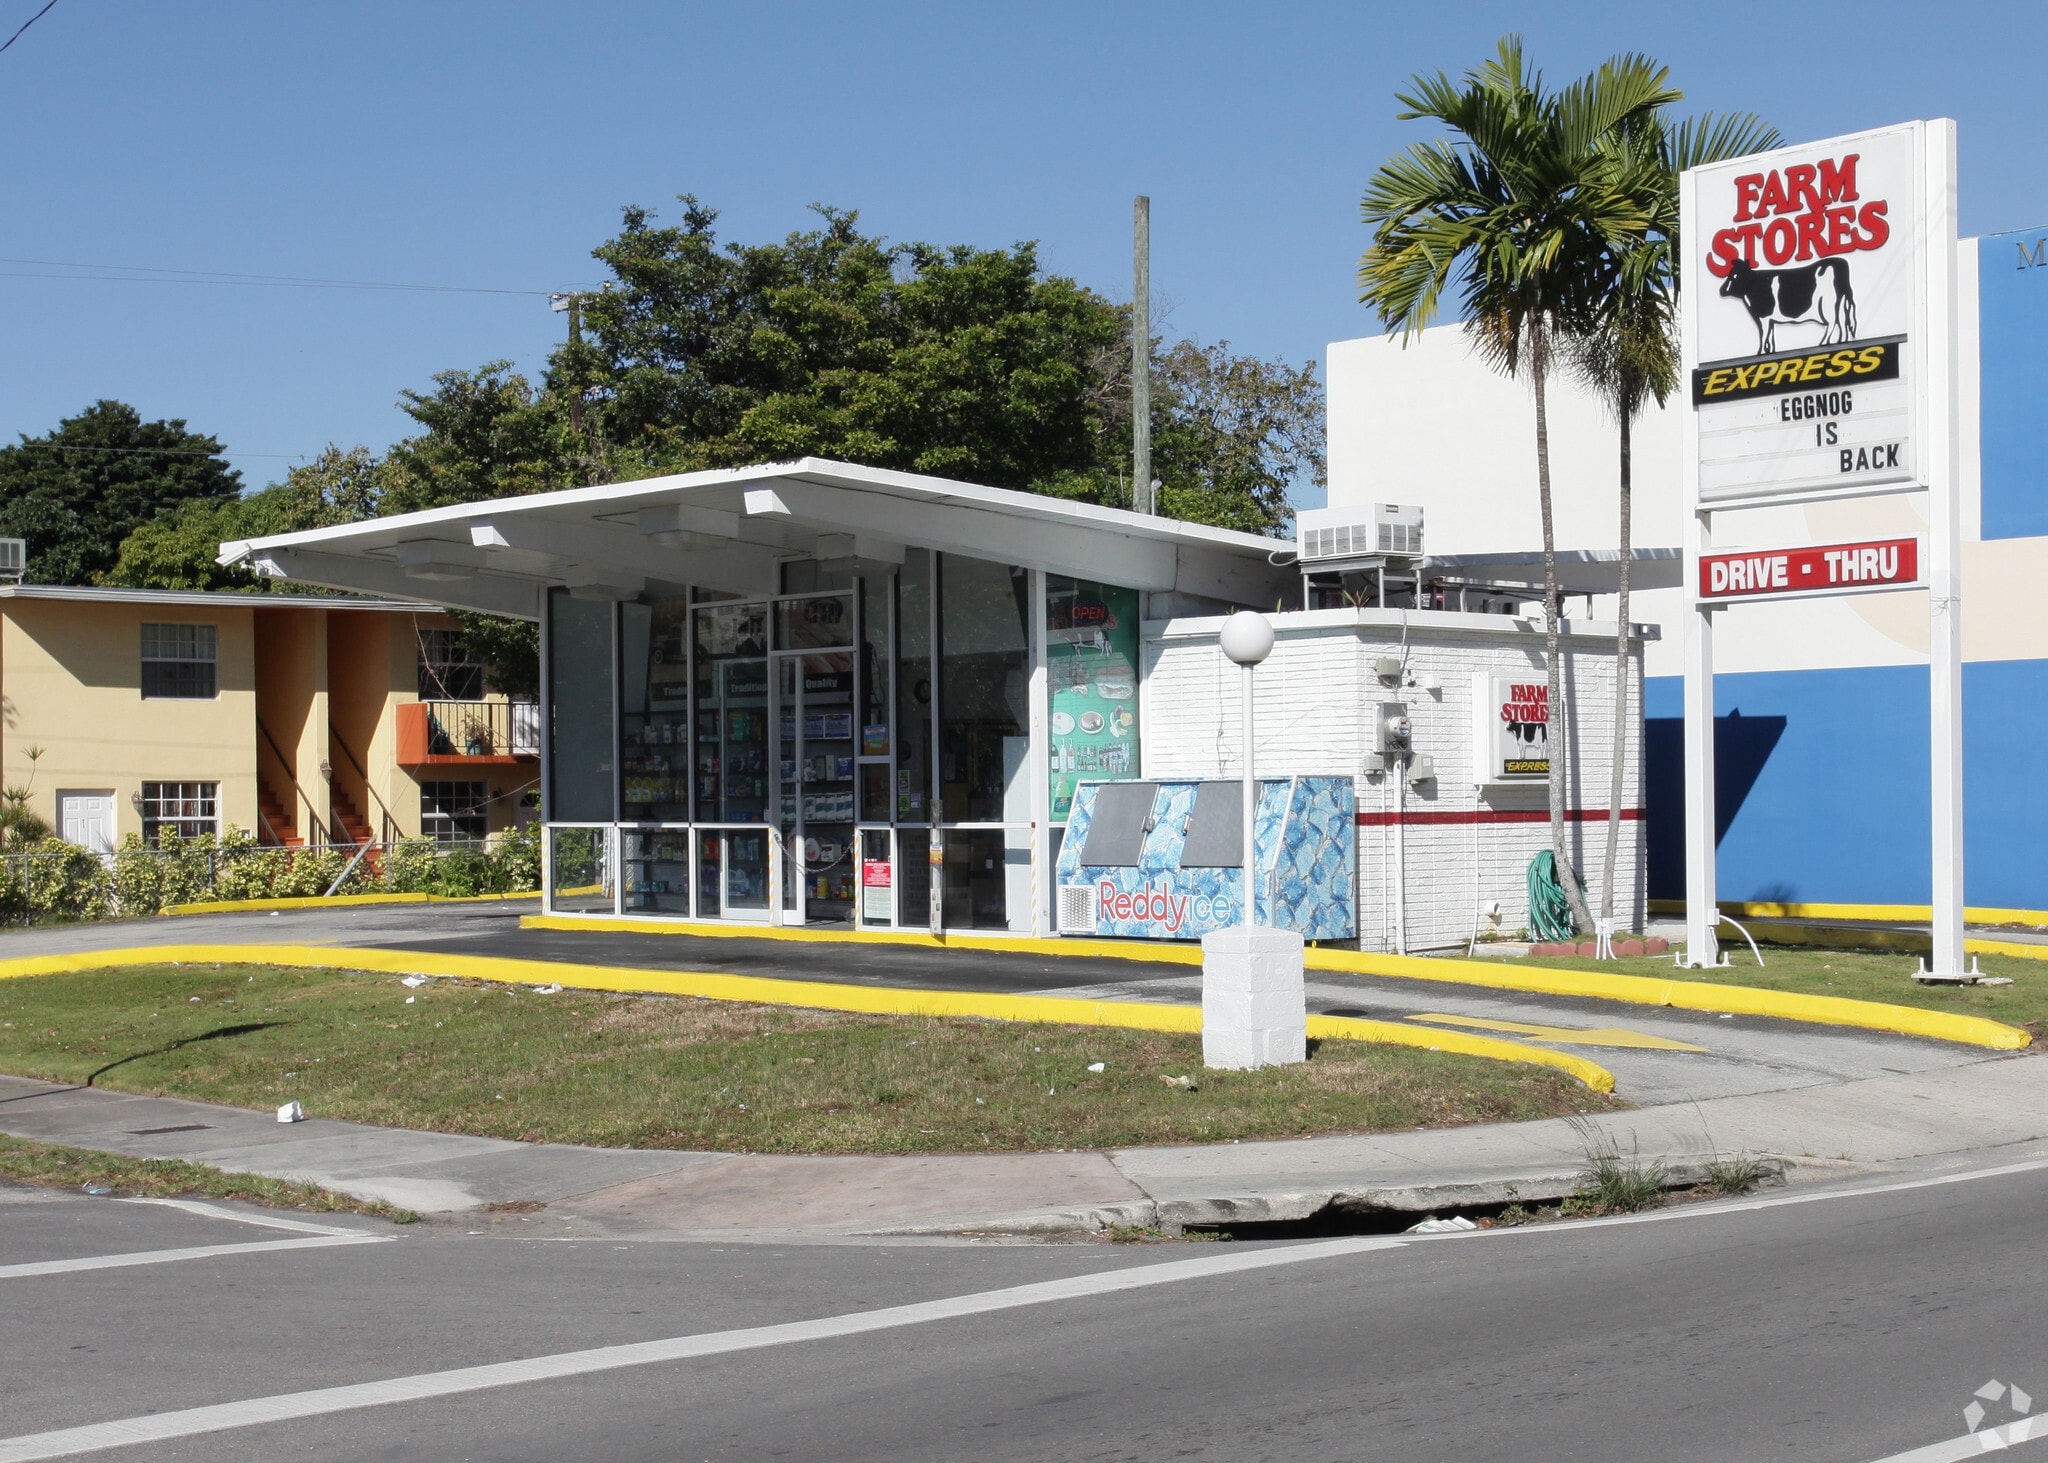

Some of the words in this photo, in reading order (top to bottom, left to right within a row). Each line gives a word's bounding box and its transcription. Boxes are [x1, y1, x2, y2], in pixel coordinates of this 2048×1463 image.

[1733, 154, 1861, 222] FARM
[1706, 199, 1890, 278] STORES
[1703, 345, 1885, 396] EXPRESS
[1780, 390, 1853, 423] EGGNOG
[1815, 422, 1838, 447] IS
[1839, 443, 1900, 474] BACK
[1710, 557, 1789, 593] DRIVE
[1823, 547, 1899, 584] THRU
[1071, 606, 1107, 621] OPEN
[805, 678, 838, 690] Quality
[1510, 684, 1549, 704] FARM
[1500, 702, 1550, 722] STORE
